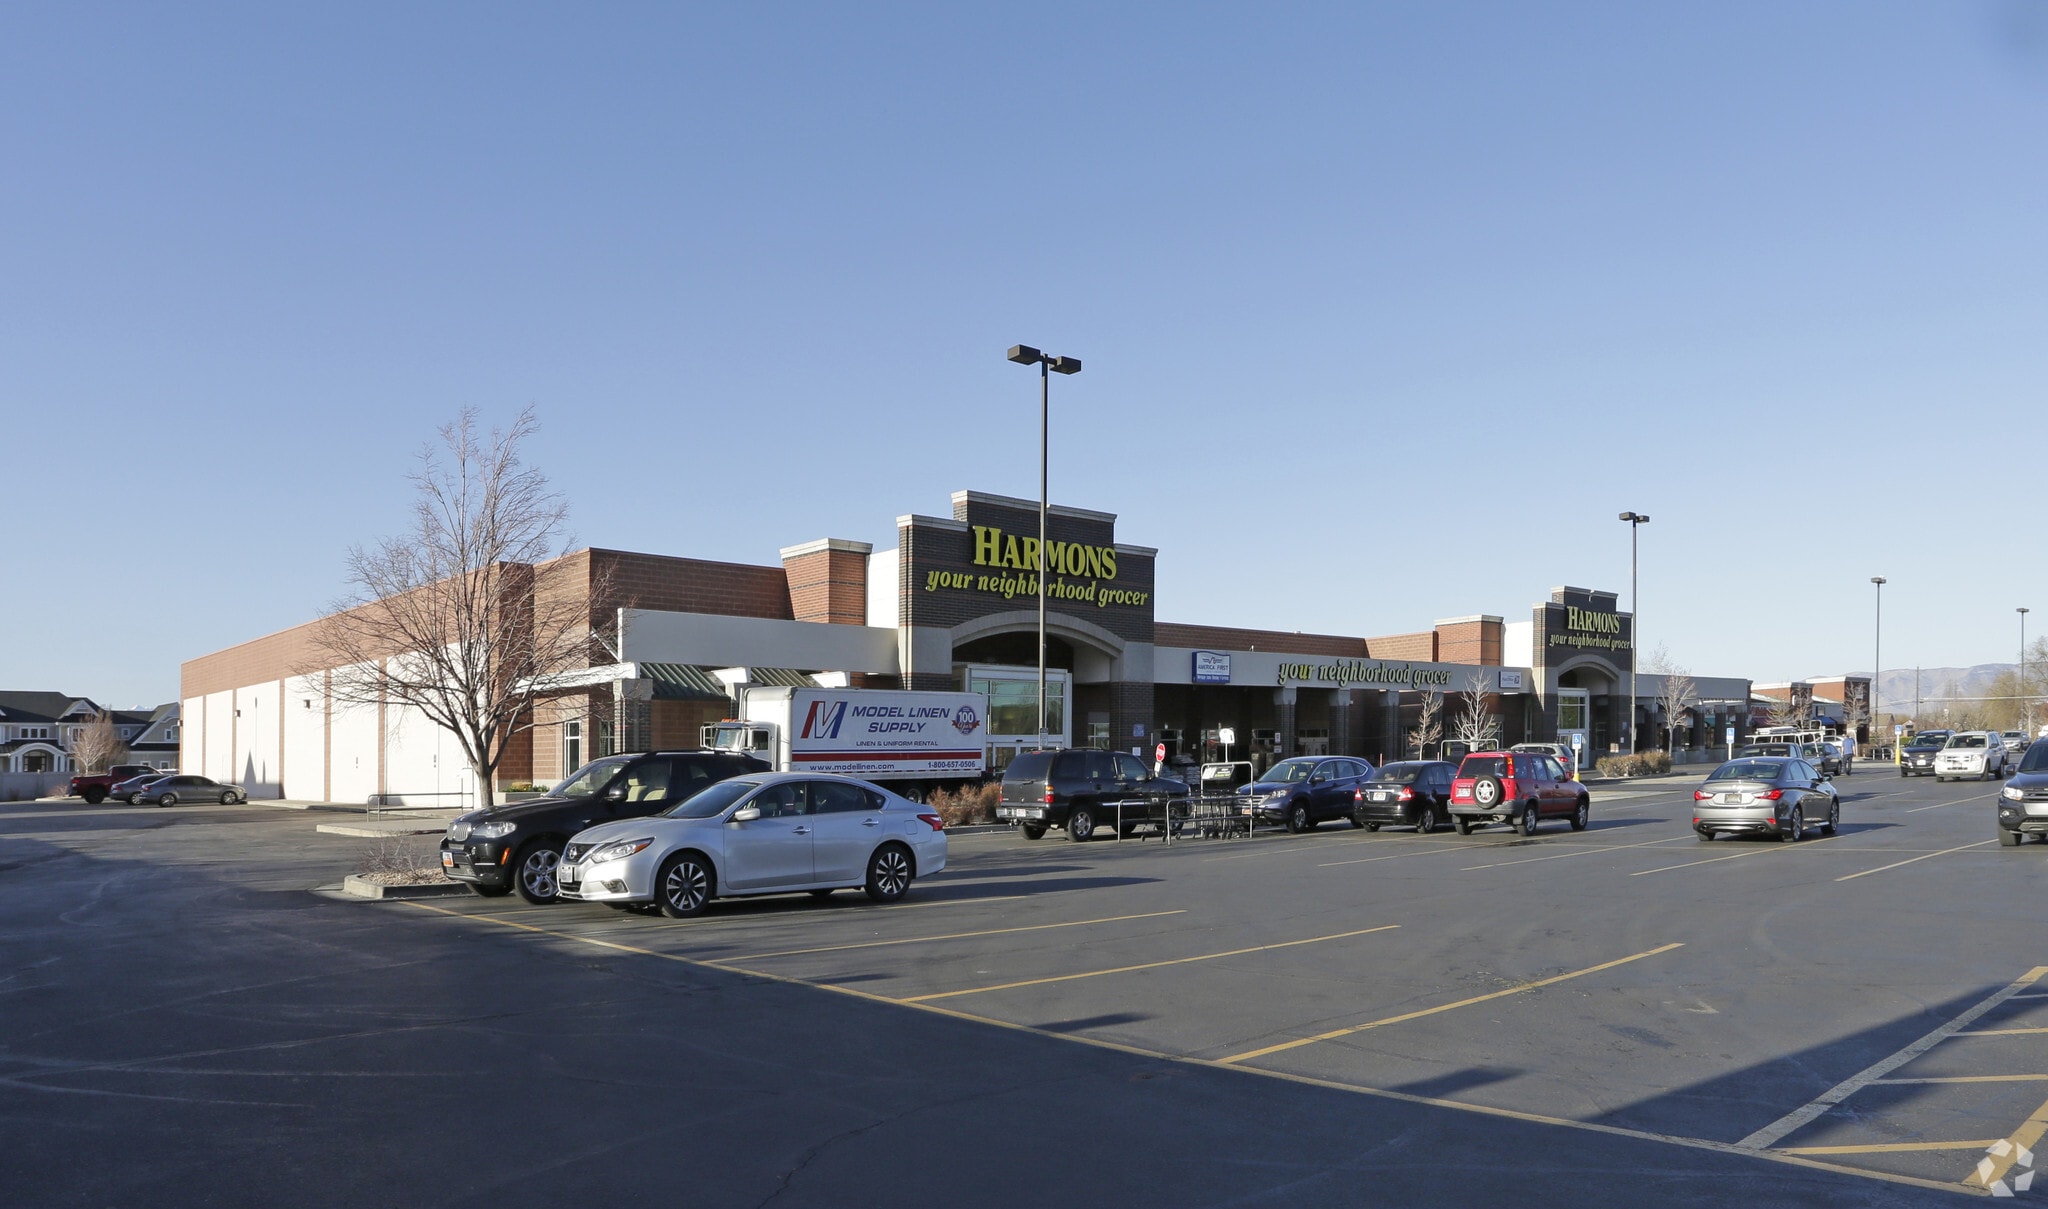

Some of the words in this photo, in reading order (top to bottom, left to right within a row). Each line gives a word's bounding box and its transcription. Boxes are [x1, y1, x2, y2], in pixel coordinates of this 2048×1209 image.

[972, 525, 1117, 580] HARMONS
[926, 570, 973, 591] your
[1098, 588, 1148, 607] grocer
[1567, 605, 1620, 634] HARMONS
[1550, 634, 1567, 646] your
[1568, 634, 1611, 649] neighborhood
[1610, 639, 1630, 651] grocer
[1279, 662, 1315, 685] your
[1319, 659, 1411, 687] neighborhood
[1412, 669, 1451, 689] grocer
[852, 706, 905, 717] MODEL
[908, 707, 950, 718] LINEN
[958, 711, 974, 723] 100
[868, 722, 926, 733] SUPPLY
[809, 762, 895, 770] www.modellinen.com
